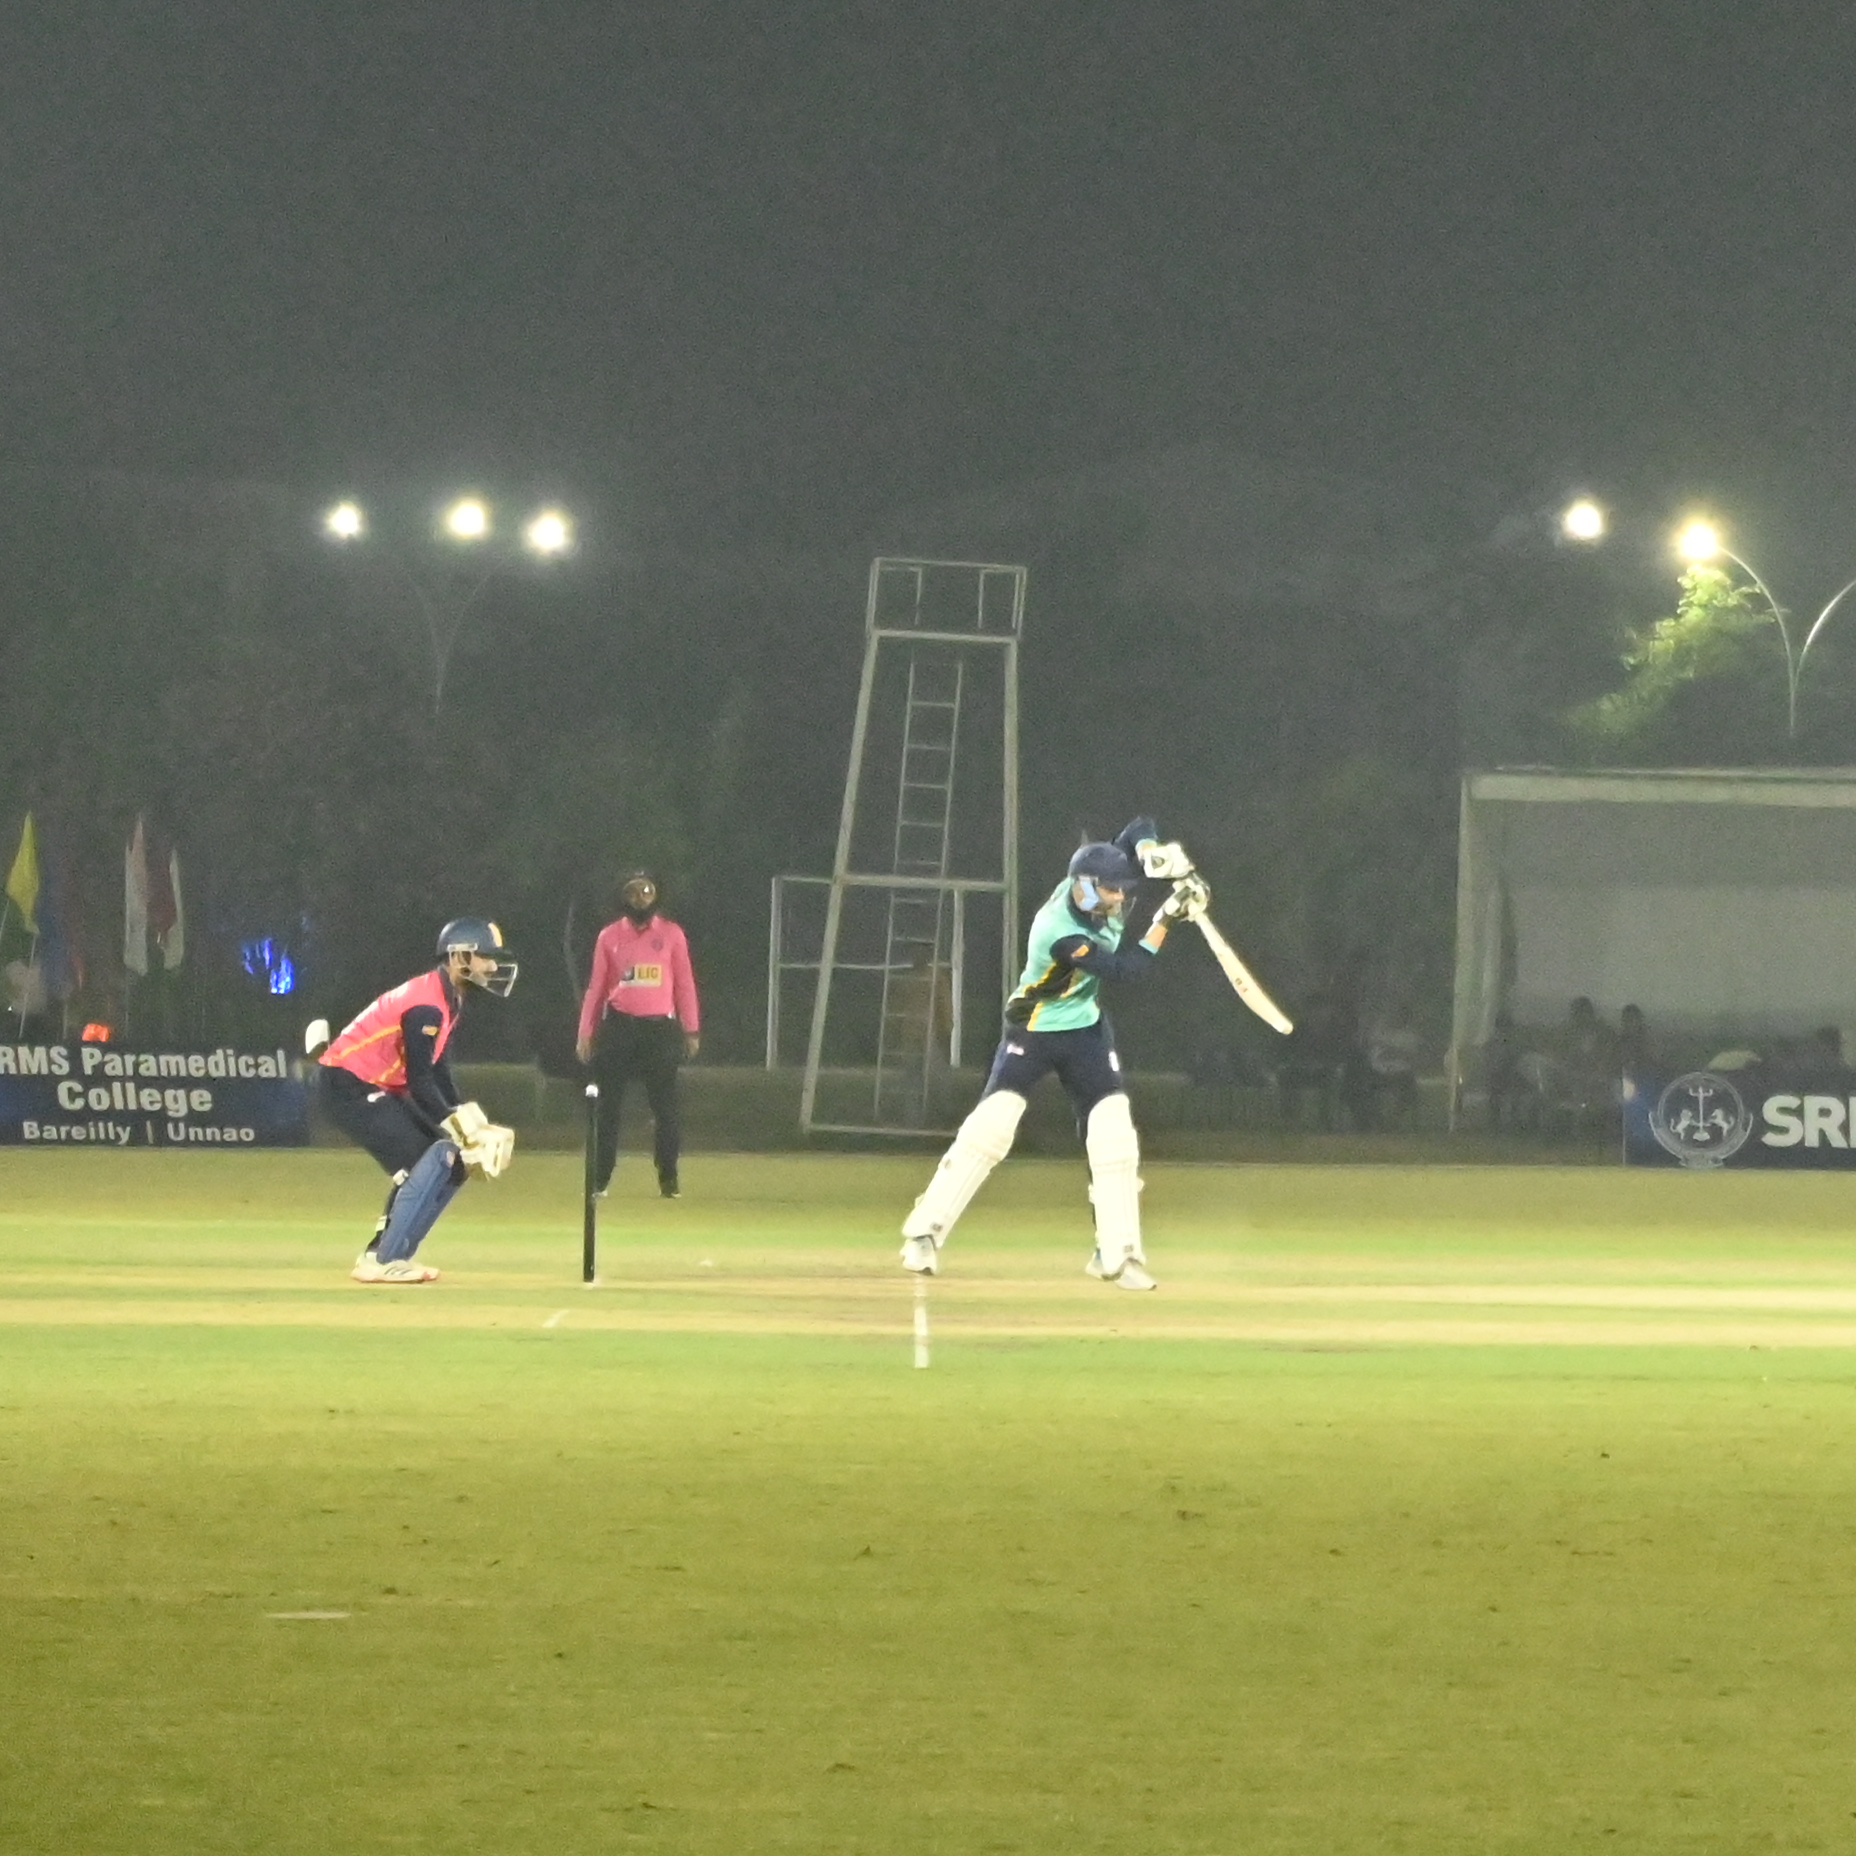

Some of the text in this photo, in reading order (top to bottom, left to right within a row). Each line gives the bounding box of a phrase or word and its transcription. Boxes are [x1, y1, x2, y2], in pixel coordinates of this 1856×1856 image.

[81, 1047, 287, 1078] Paramedical
[57, 1081, 213, 1118] College
[22, 1120, 131, 1145] Bareilly
[167, 1121, 255, 1142] Unnao
